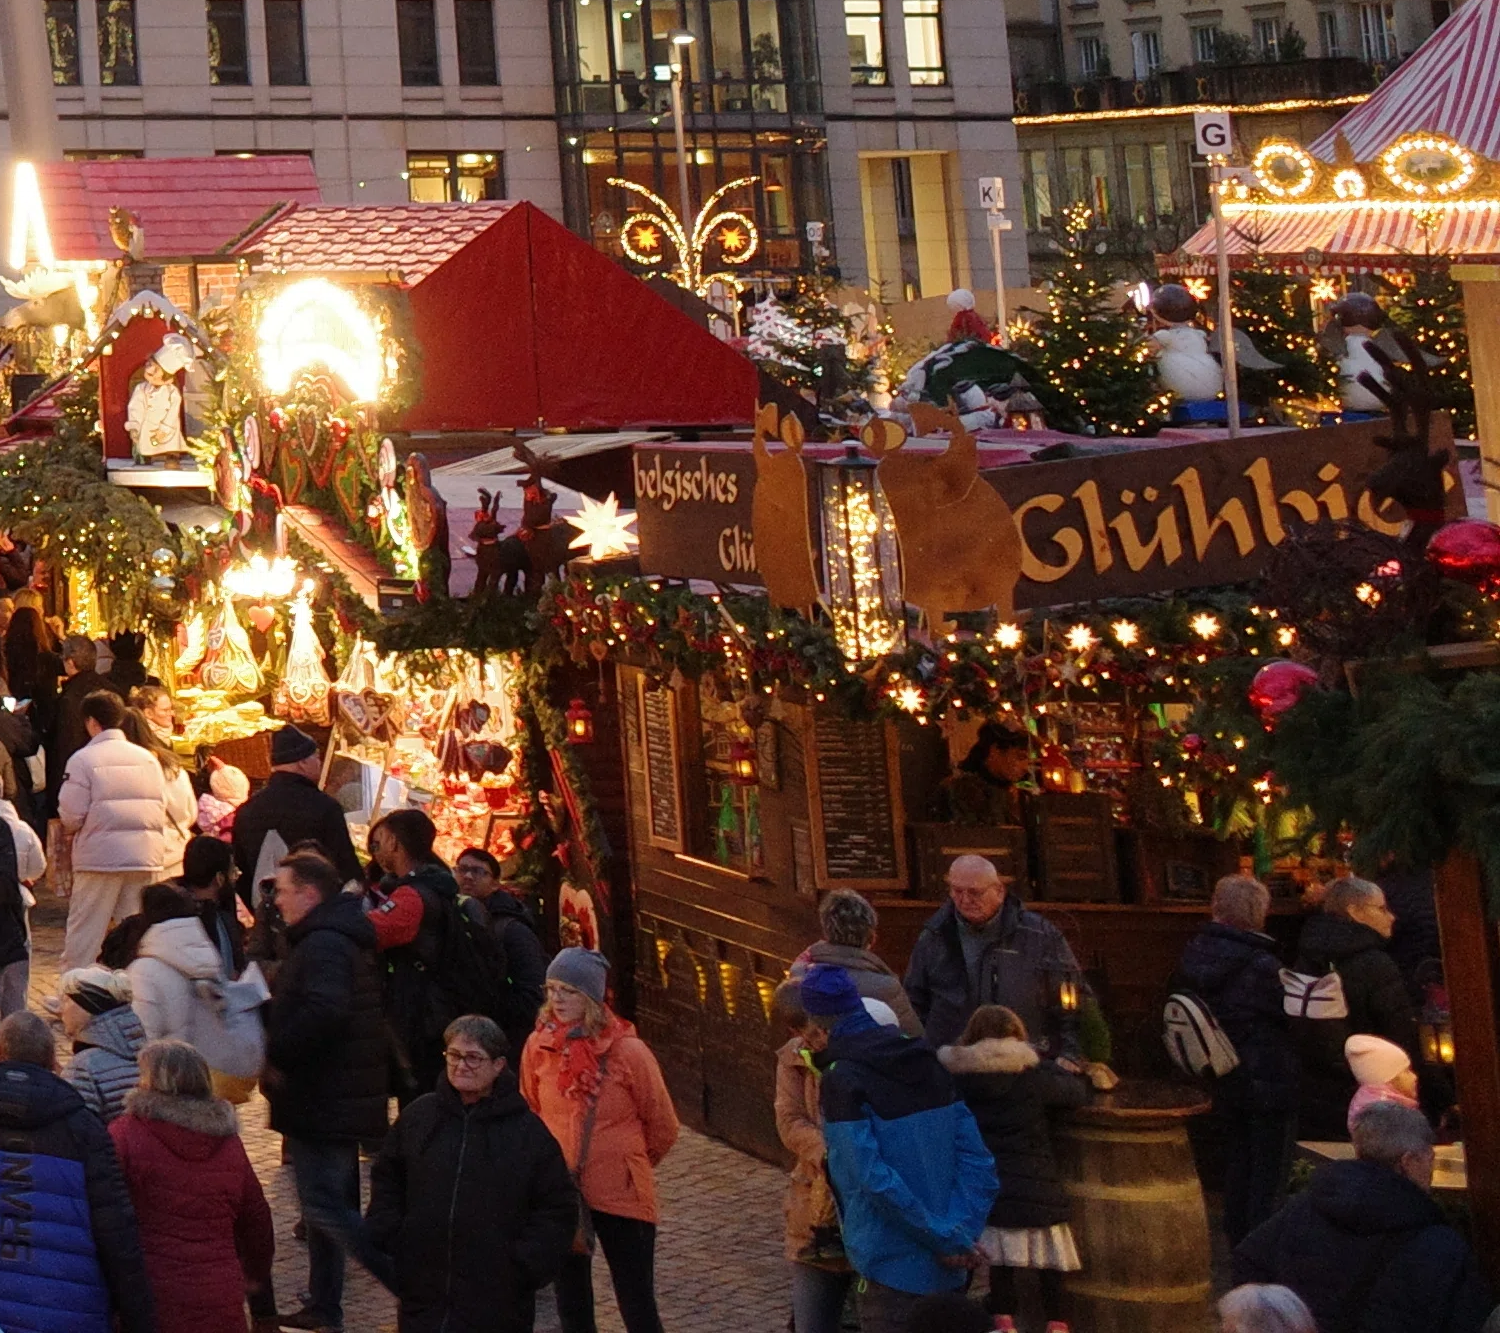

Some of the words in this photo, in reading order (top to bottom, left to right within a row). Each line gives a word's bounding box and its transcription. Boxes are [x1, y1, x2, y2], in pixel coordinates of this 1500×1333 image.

[1201, 123, 1226, 147] G
[982, 186, 994, 202] K
[632, 451, 739, 511] belgisches
[1012, 456, 1455, 583] Glühbie
